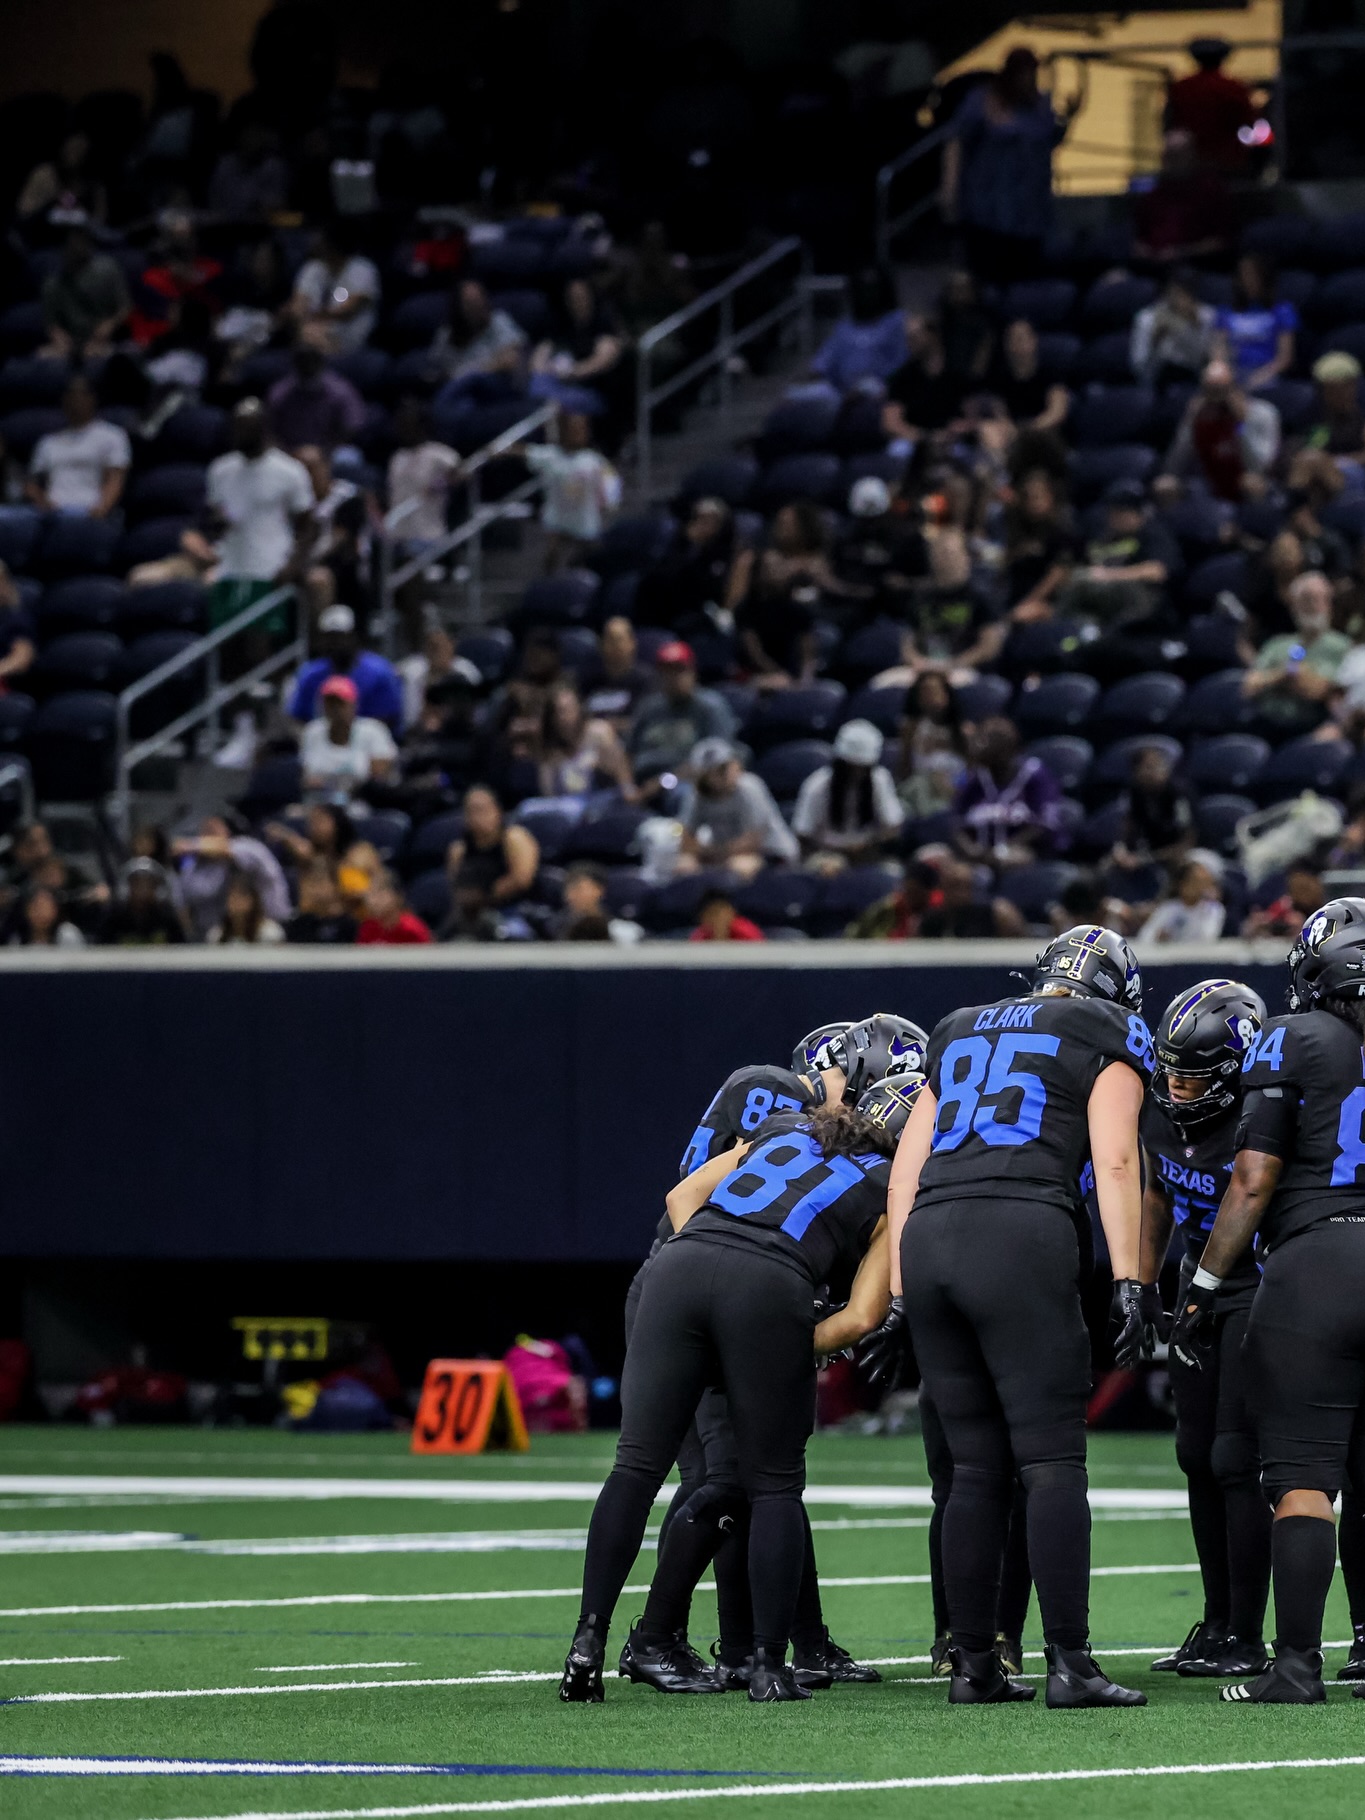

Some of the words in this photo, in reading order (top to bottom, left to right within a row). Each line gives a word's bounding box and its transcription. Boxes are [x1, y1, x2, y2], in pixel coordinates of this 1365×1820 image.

[1057, 955, 1073, 970] 85
[973, 1004, 1043, 1031] CLARK
[931, 1032, 1061, 1153] 85
[709, 1131, 866, 1242] 81
[1158, 1153, 1216, 1196] TEXAS
[422, 1372, 485, 1443] 30
